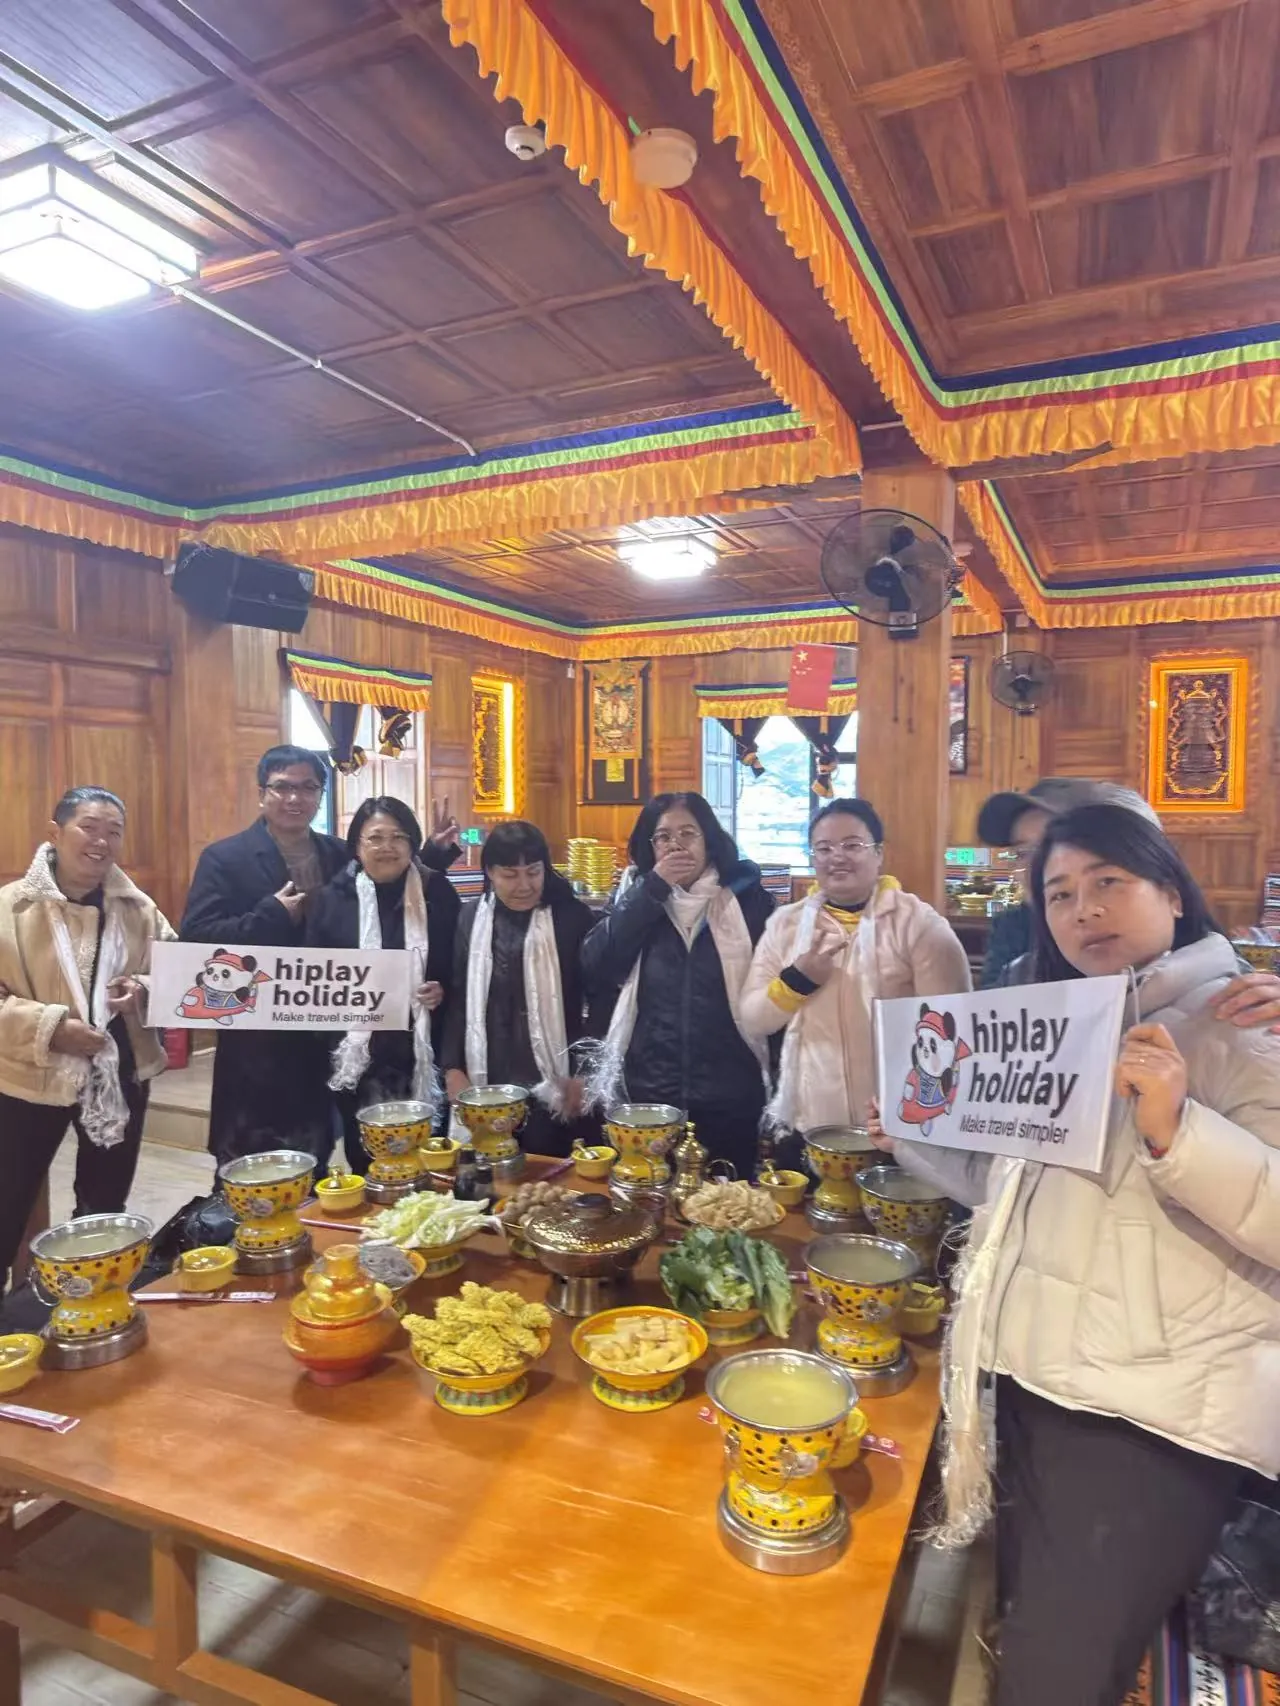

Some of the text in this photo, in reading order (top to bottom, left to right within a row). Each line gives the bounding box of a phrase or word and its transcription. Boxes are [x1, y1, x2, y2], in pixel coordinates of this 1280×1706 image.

[275, 957, 372, 987] hiplay
[273, 984, 386, 1012] holiday
[272, 1012, 385, 1024] Make travel simpler
[971, 1008, 1069, 1063] hiplay
[968, 1060, 1080, 1118] holiday
[959, 1114, 1069, 1147] Make travel simpler
